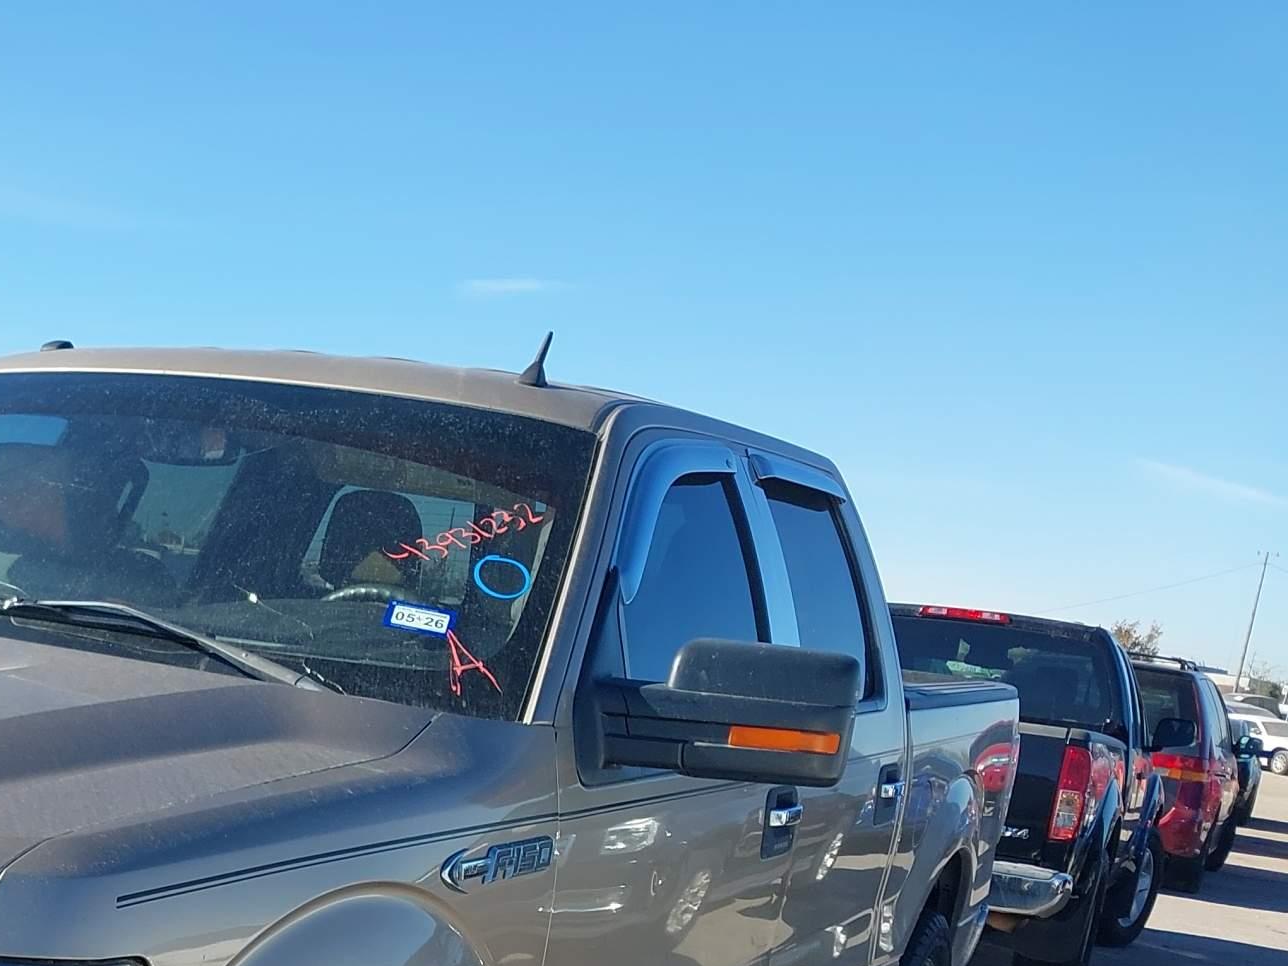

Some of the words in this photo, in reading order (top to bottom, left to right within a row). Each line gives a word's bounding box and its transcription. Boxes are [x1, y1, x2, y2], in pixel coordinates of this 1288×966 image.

[383, 503, 544, 560] 43931232
[395, 611, 416, 623] 05
[424, 617, 445, 629] 26
[446, 629, 504, 697] A
